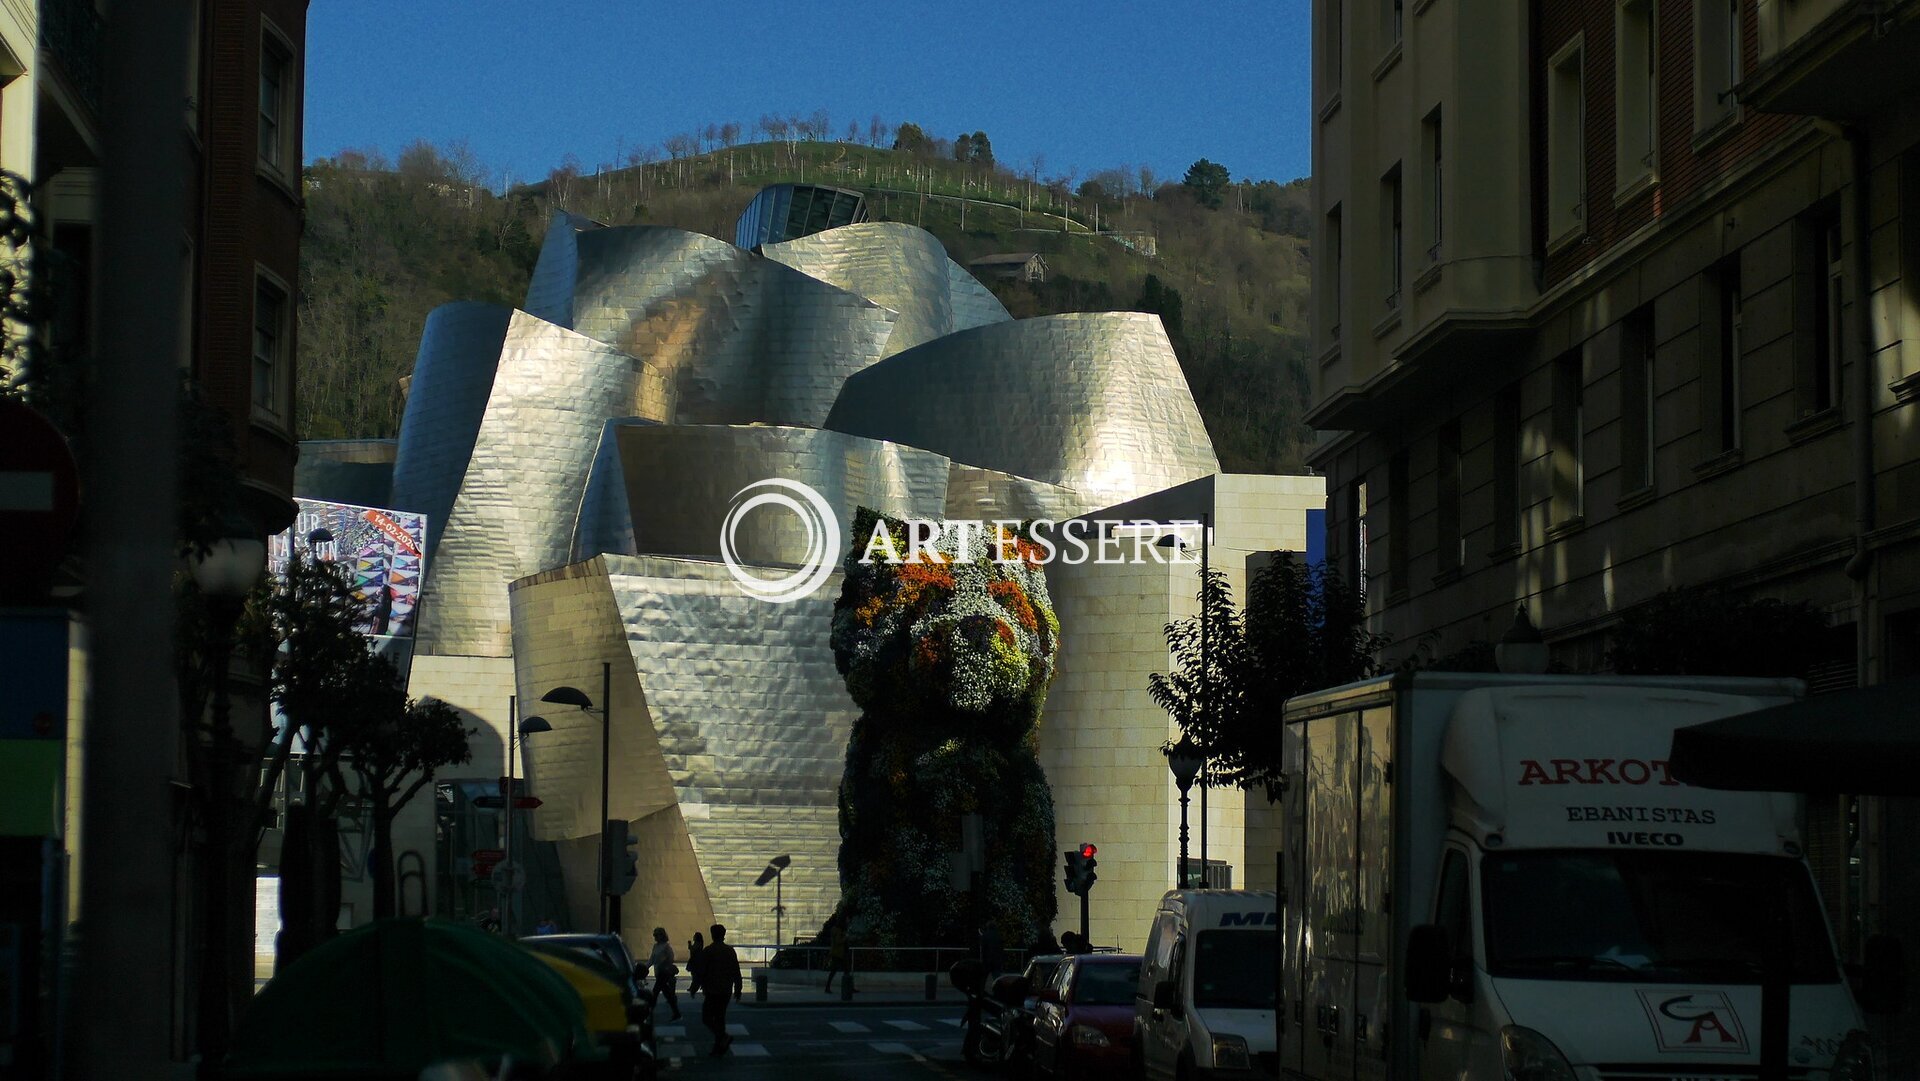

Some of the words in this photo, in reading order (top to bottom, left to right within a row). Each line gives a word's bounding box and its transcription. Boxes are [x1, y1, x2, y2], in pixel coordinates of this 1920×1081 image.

[1518, 759, 1681, 785] ARKOT
[1566, 807, 1716, 824] EBANISTAS
[1607, 831, 1684, 846] IVECO
